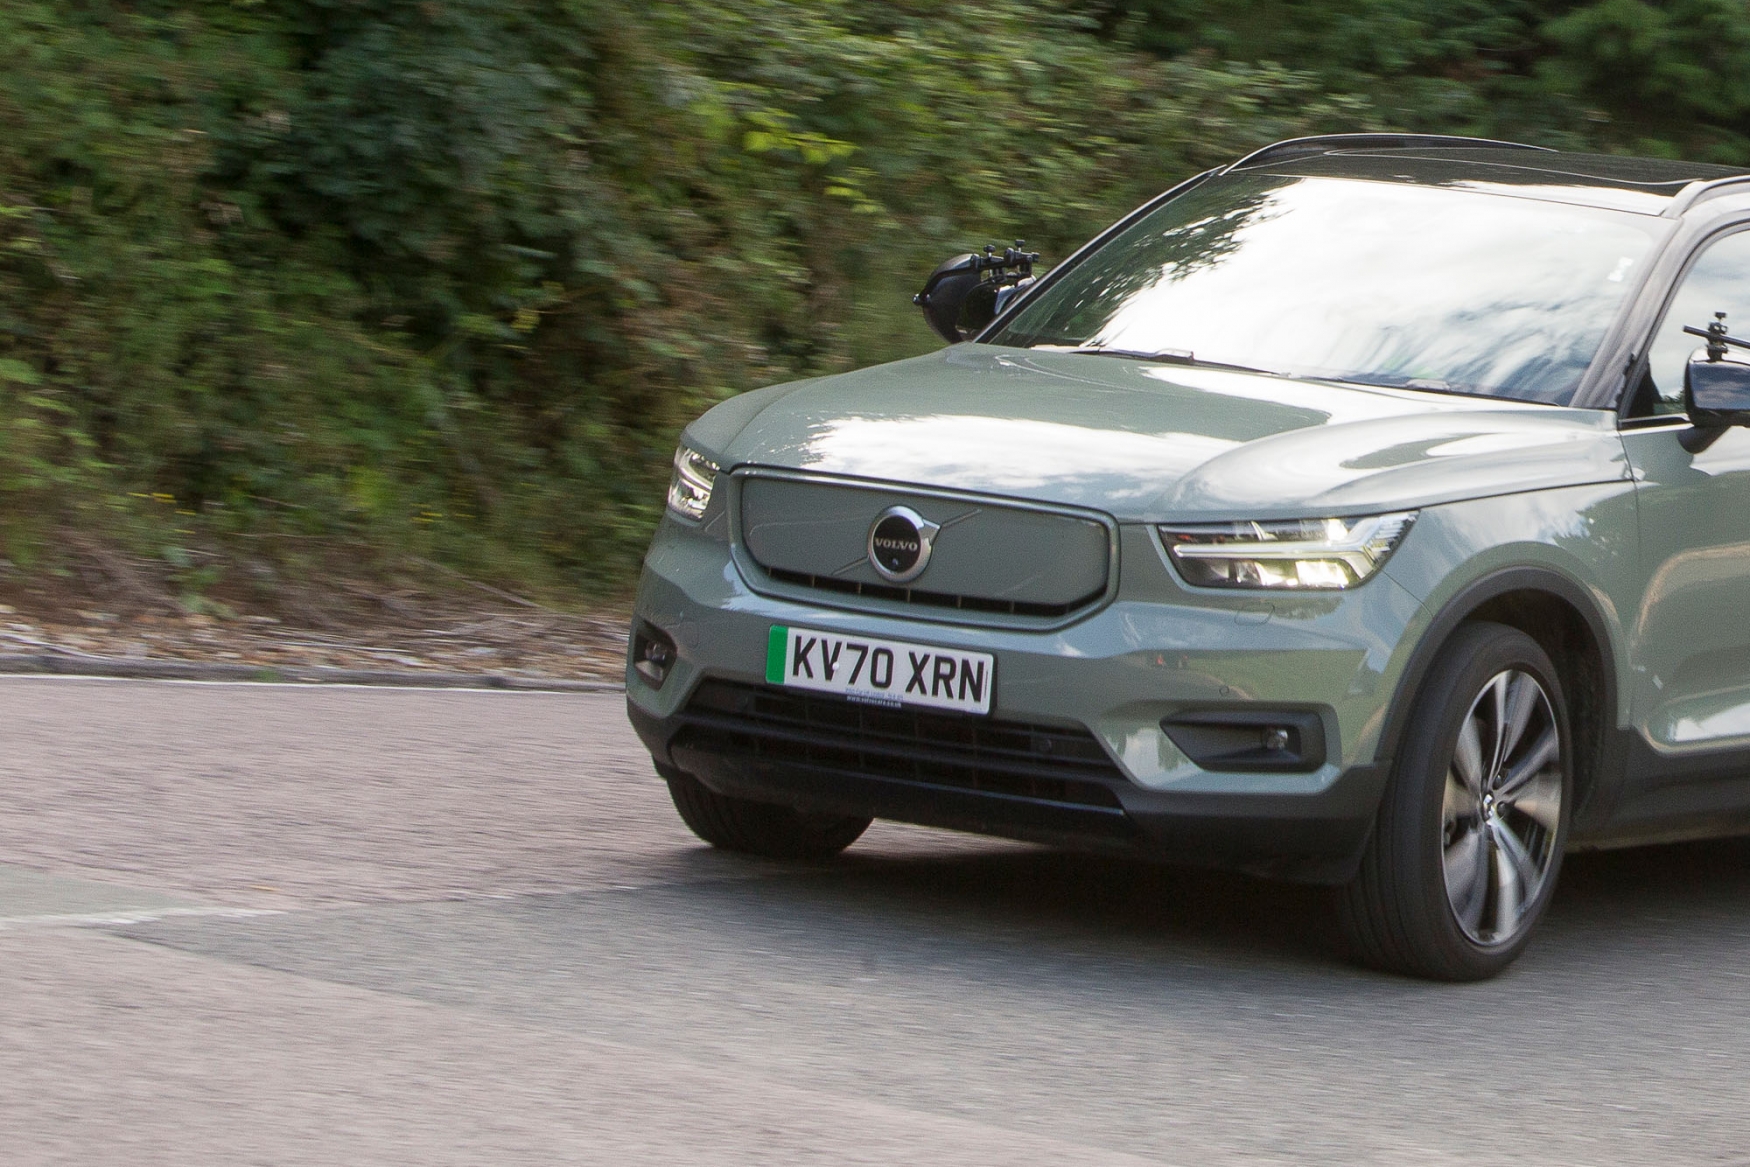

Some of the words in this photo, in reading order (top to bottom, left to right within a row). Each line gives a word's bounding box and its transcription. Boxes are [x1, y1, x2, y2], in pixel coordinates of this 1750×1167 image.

[875, 537, 918, 552] VOLVO
[792, 635, 895, 689] KV70
[905, 650, 985, 703] XRN
